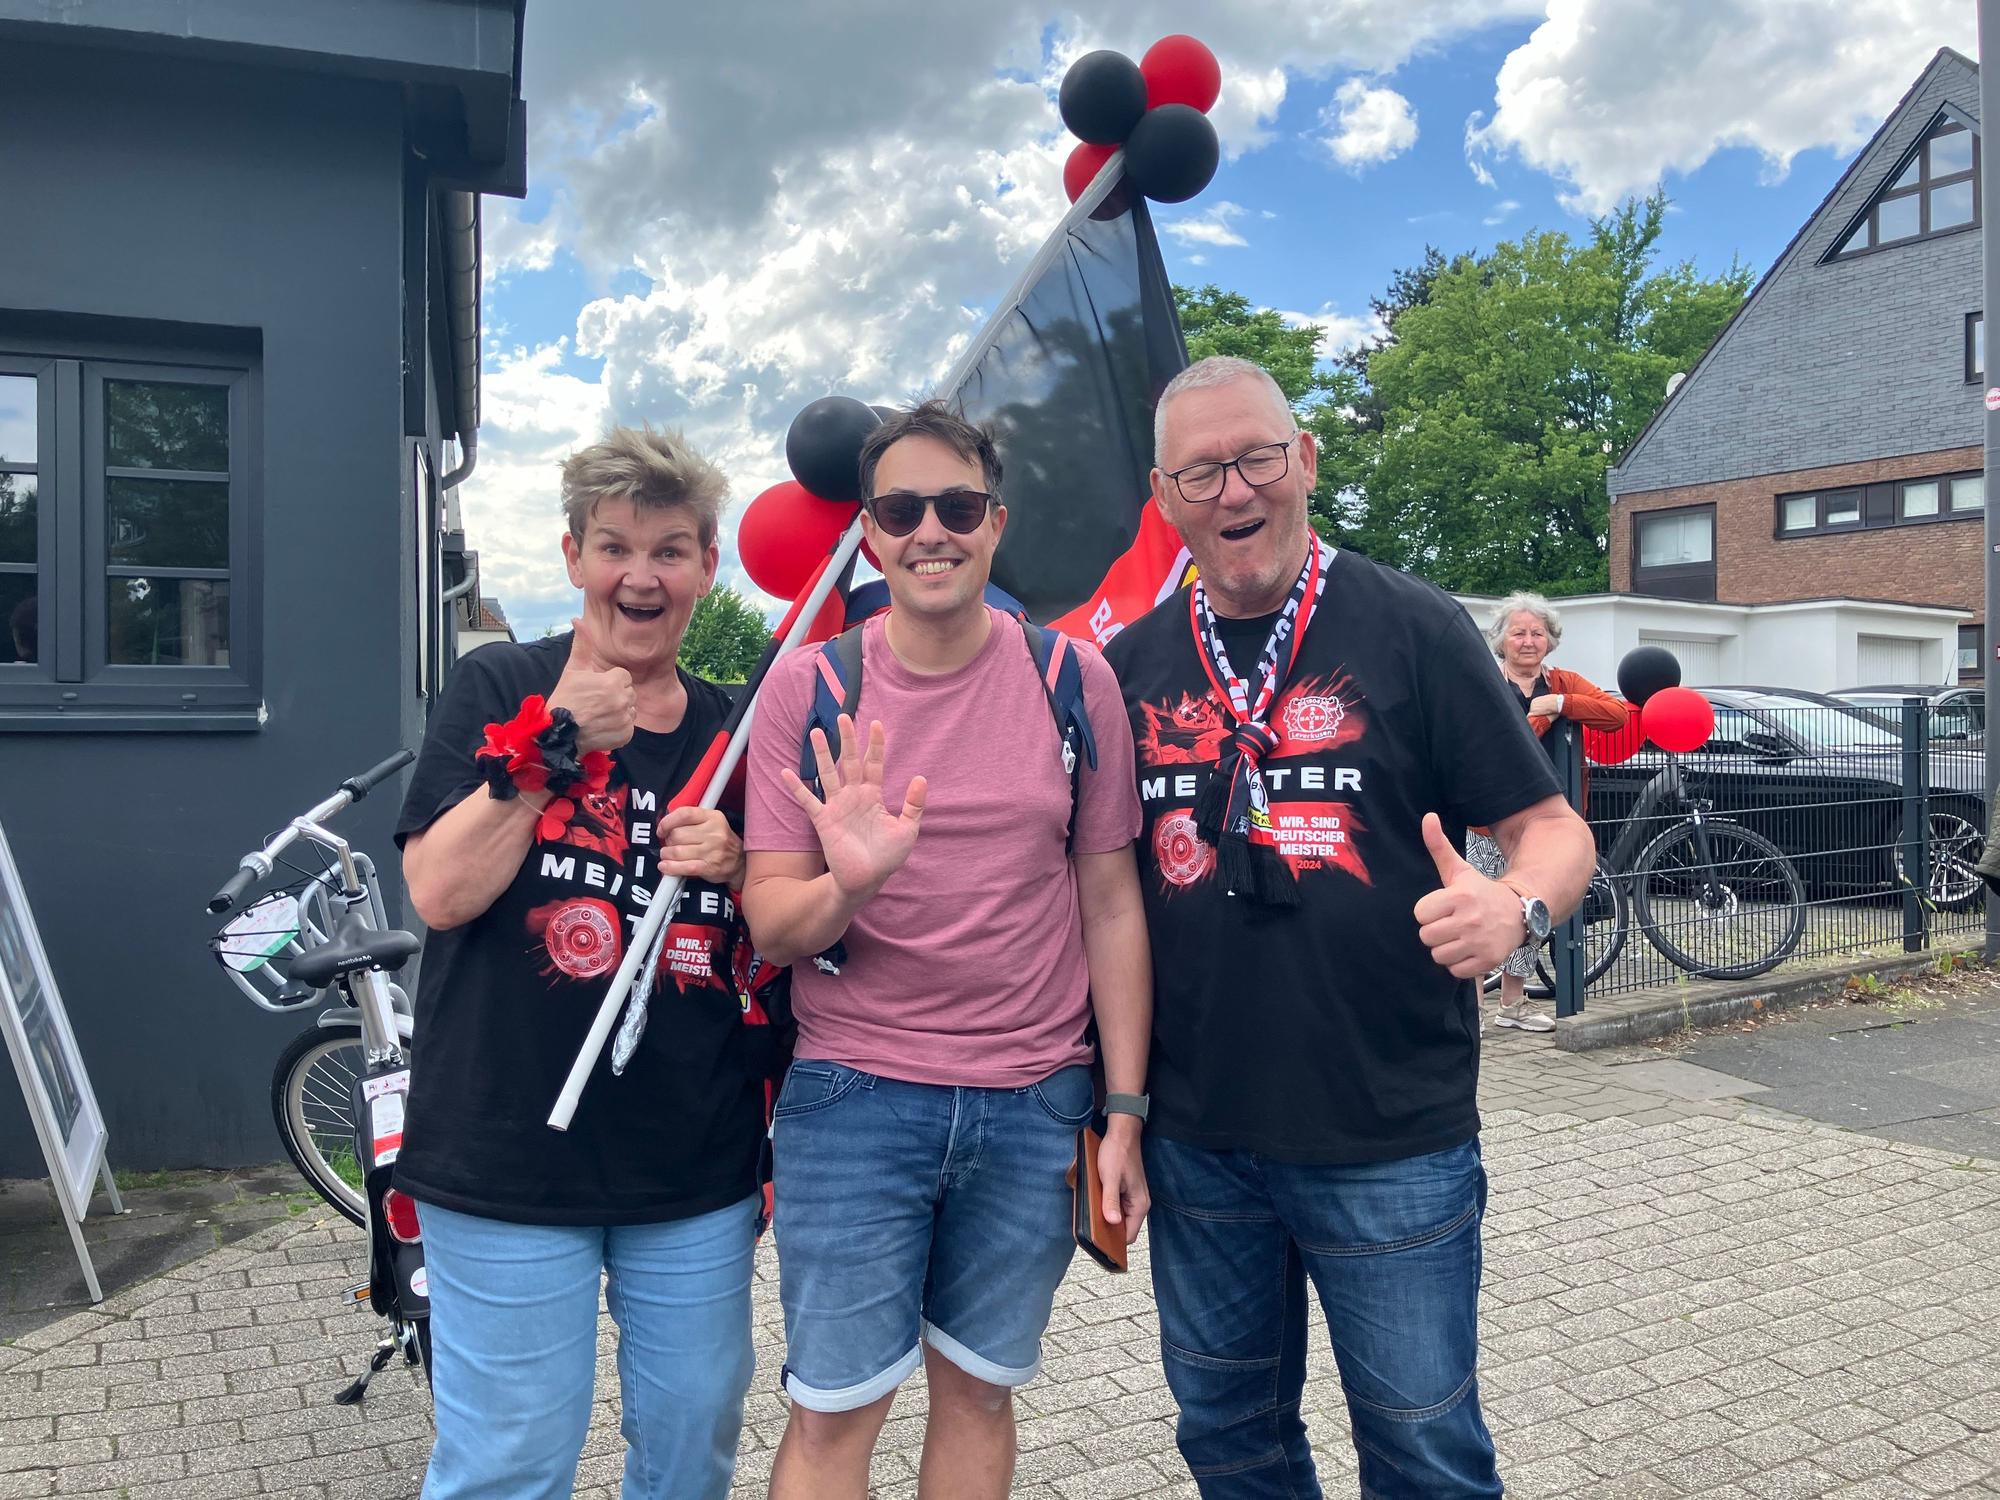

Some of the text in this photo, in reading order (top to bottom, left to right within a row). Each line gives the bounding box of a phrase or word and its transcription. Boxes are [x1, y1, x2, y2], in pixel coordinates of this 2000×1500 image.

[1142, 767, 1362, 801] METER
[1279, 816, 1309, 828] WIR.
[1311, 816, 1340, 829] SIND
[1272, 829, 1346, 843] DEUTSCHER
[1279, 843, 1338, 857] MEISTER.
[1297, 859, 1322, 870] 2024
[675, 937, 702, 951] WIR.
[666, 949, 711, 964] DEUTSC
[670, 961, 713, 977] MEISTE
